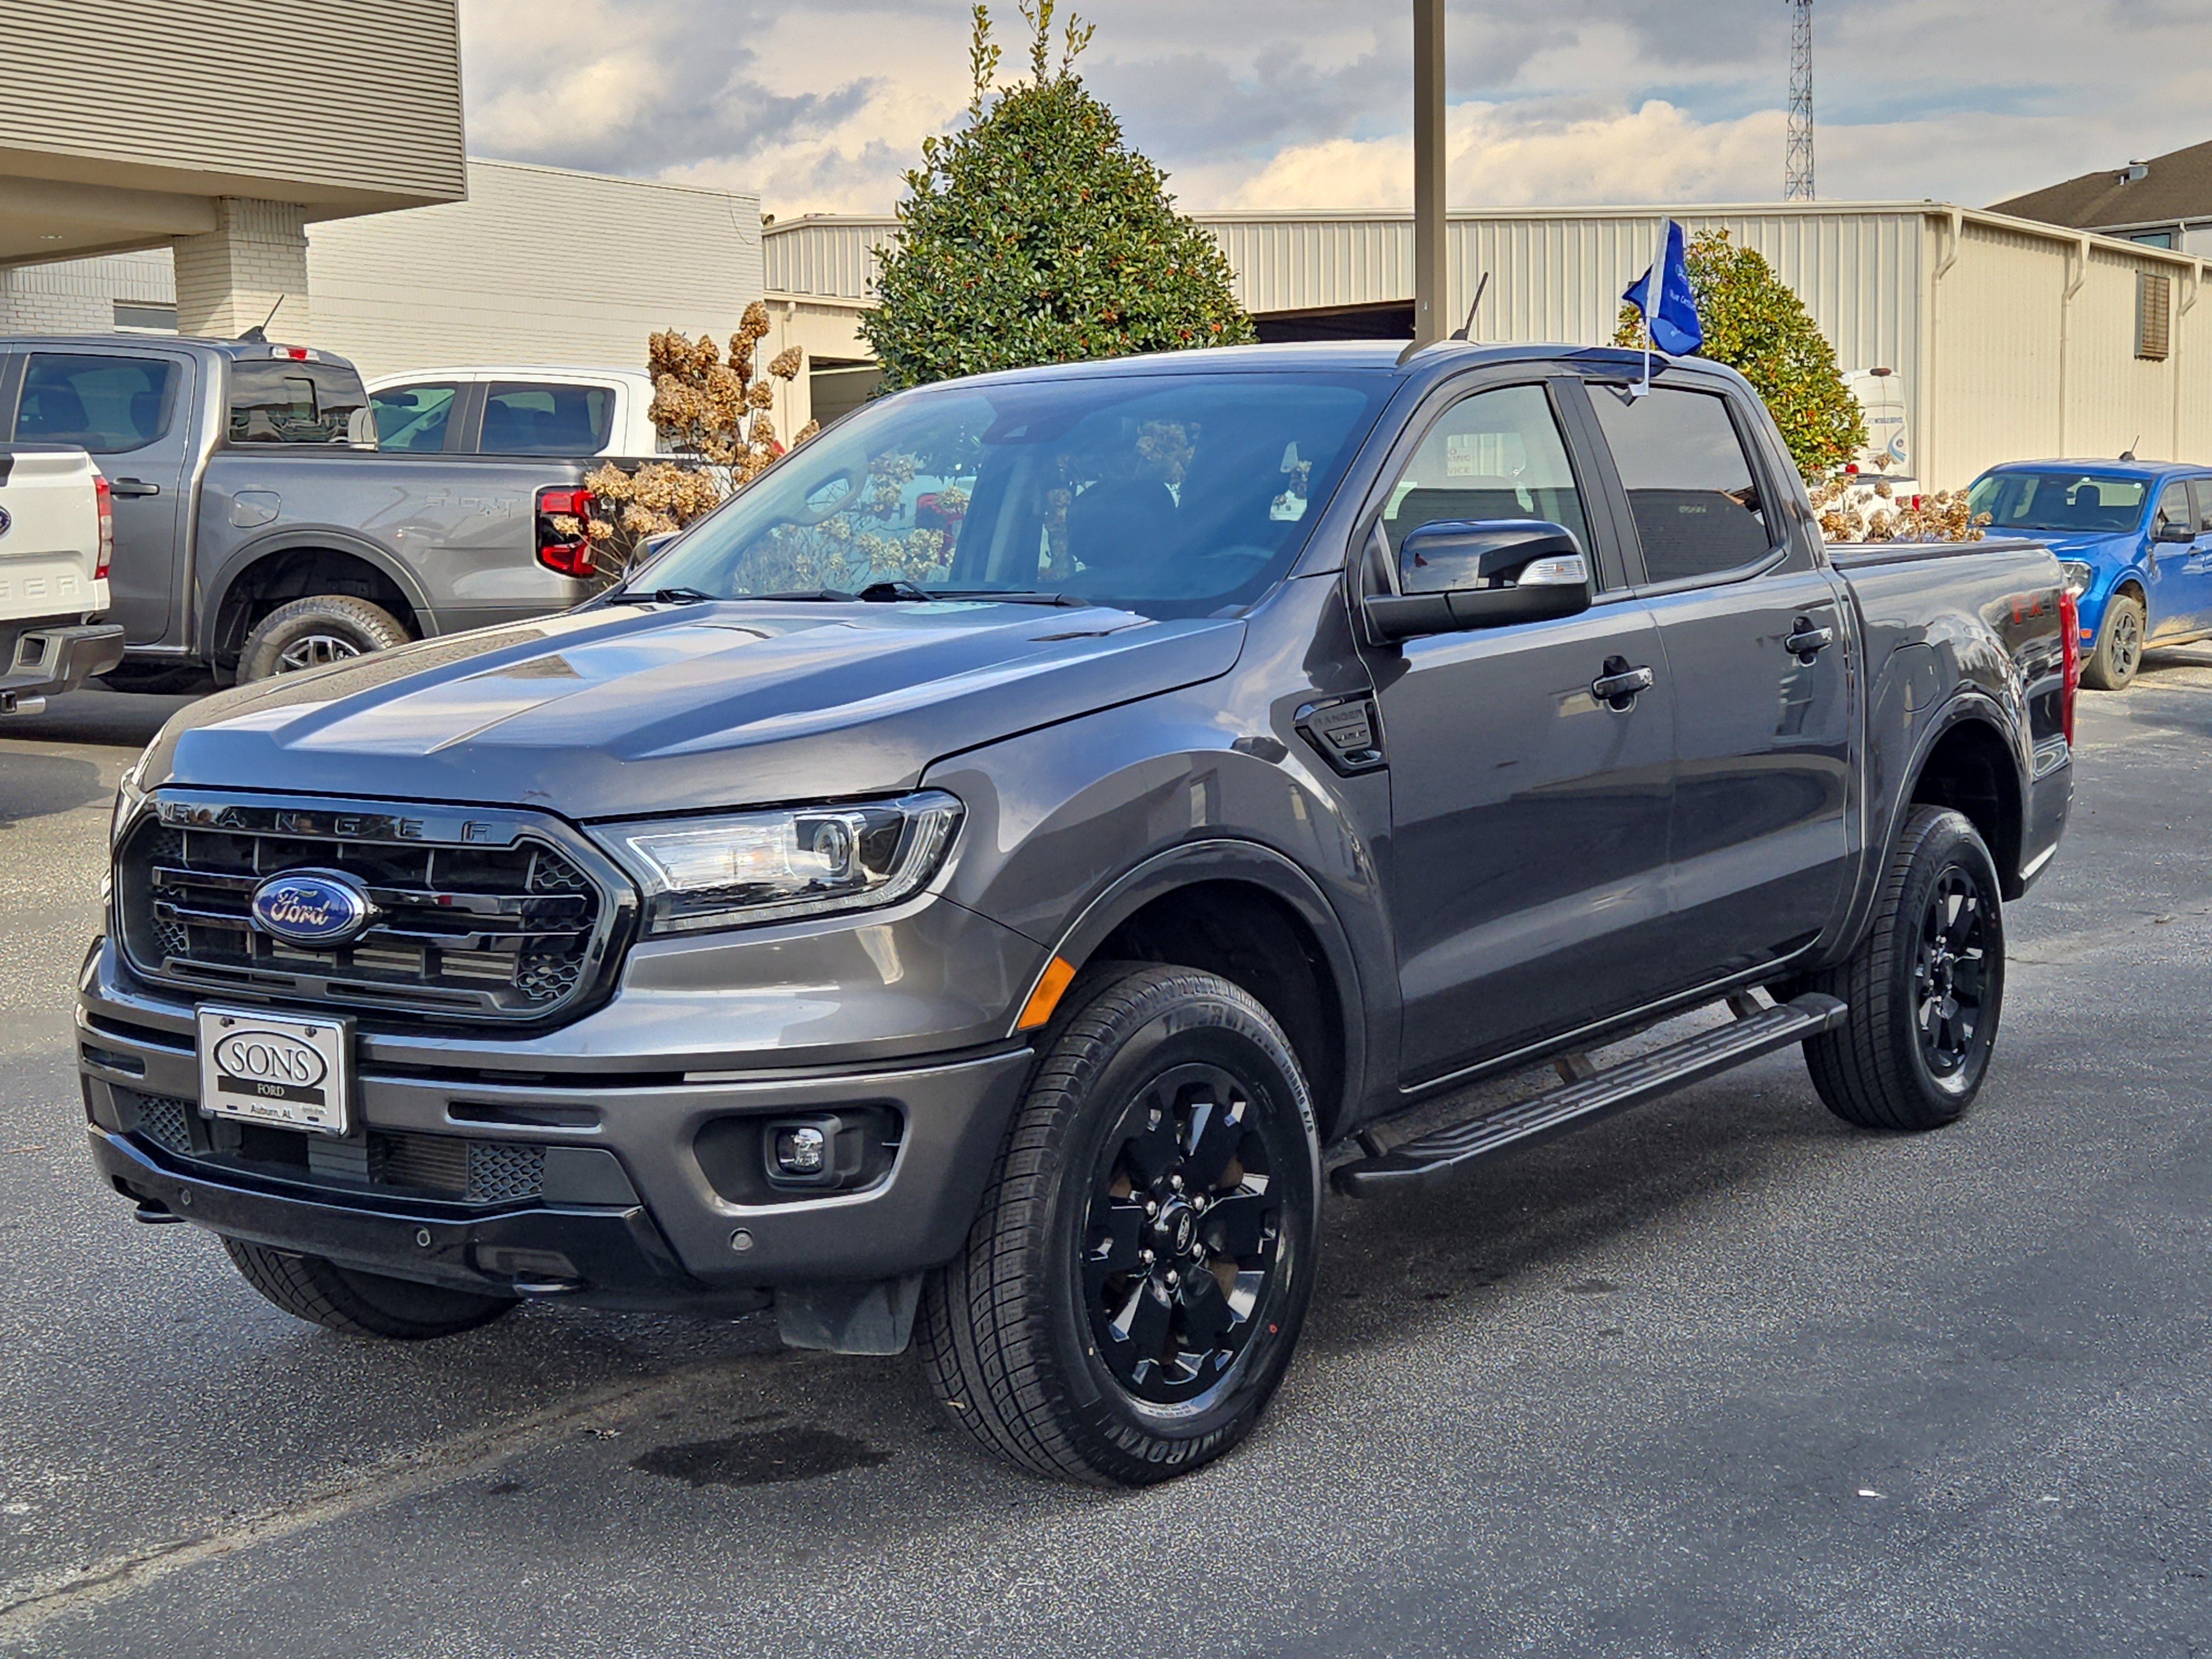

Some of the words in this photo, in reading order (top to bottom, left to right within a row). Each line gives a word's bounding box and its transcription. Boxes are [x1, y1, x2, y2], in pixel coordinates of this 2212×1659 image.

[2011, 593, 2057, 625] FX4
[1314, 708, 1365, 727] RANGER
[165, 803, 492, 843] RANGER
[270, 886, 331, 926] Ford
[230, 1041, 310, 1081] SONS
[257, 1084, 285, 1097] FORD
